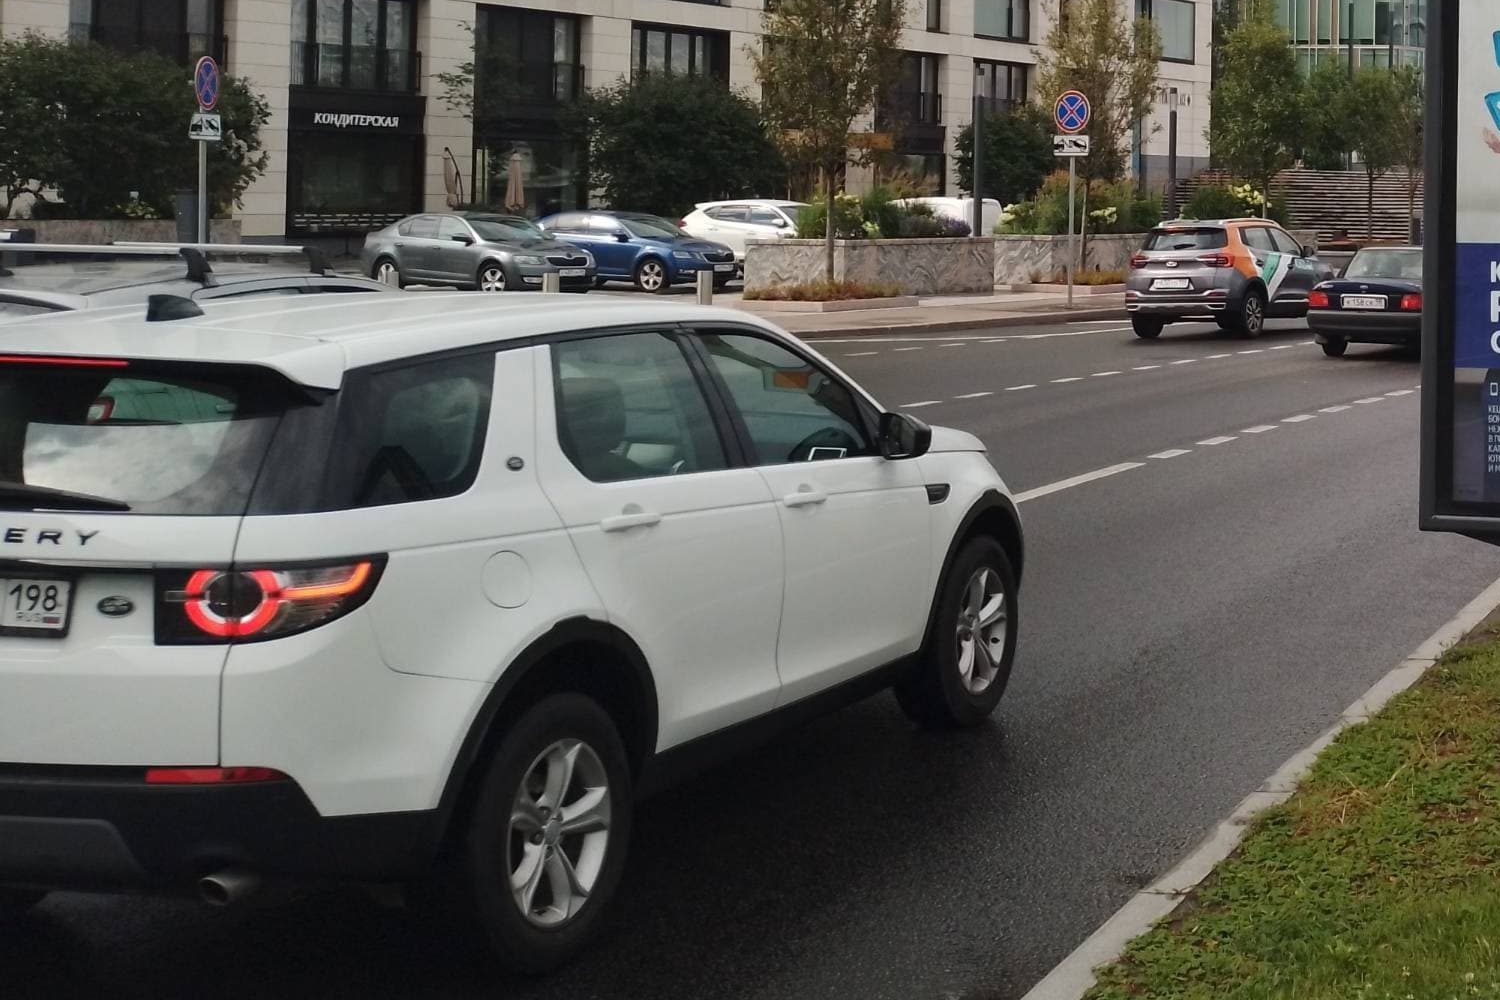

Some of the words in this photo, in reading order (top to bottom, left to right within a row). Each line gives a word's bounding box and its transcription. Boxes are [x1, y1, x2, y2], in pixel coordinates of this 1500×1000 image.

[313, 112, 400, 128] КОНДИТЕРСКАЯ
[4, 527, 100, 546] ERY
[9, 583, 58, 612] 198
